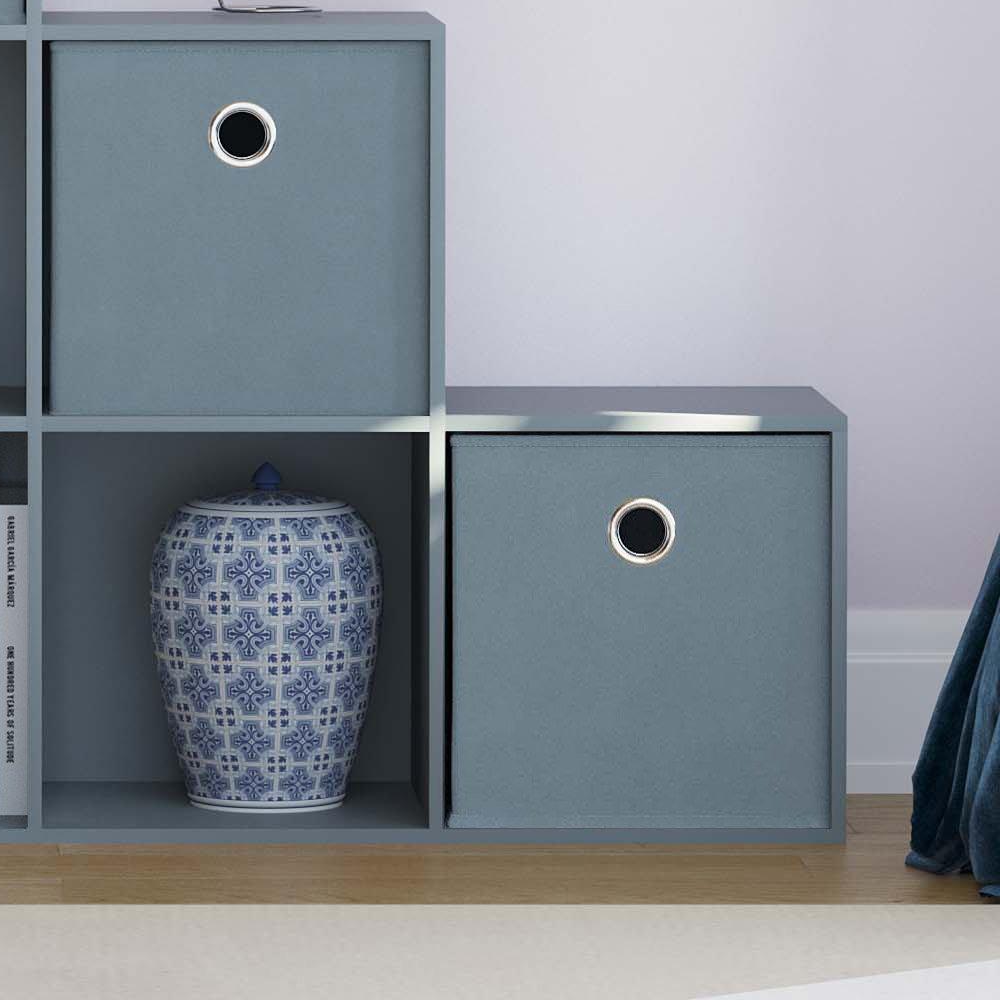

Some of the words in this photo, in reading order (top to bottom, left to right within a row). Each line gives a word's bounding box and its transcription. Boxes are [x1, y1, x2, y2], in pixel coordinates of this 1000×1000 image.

[7, 515, 15, 545] GABRIEL
[6, 645, 15, 659] ONE
[6, 661, 15, 693] HUNDRED
[6, 694, 15, 718] YEARS
[6, 719, 15, 729] OF
[6, 730, 15, 764] SOLITUDE
